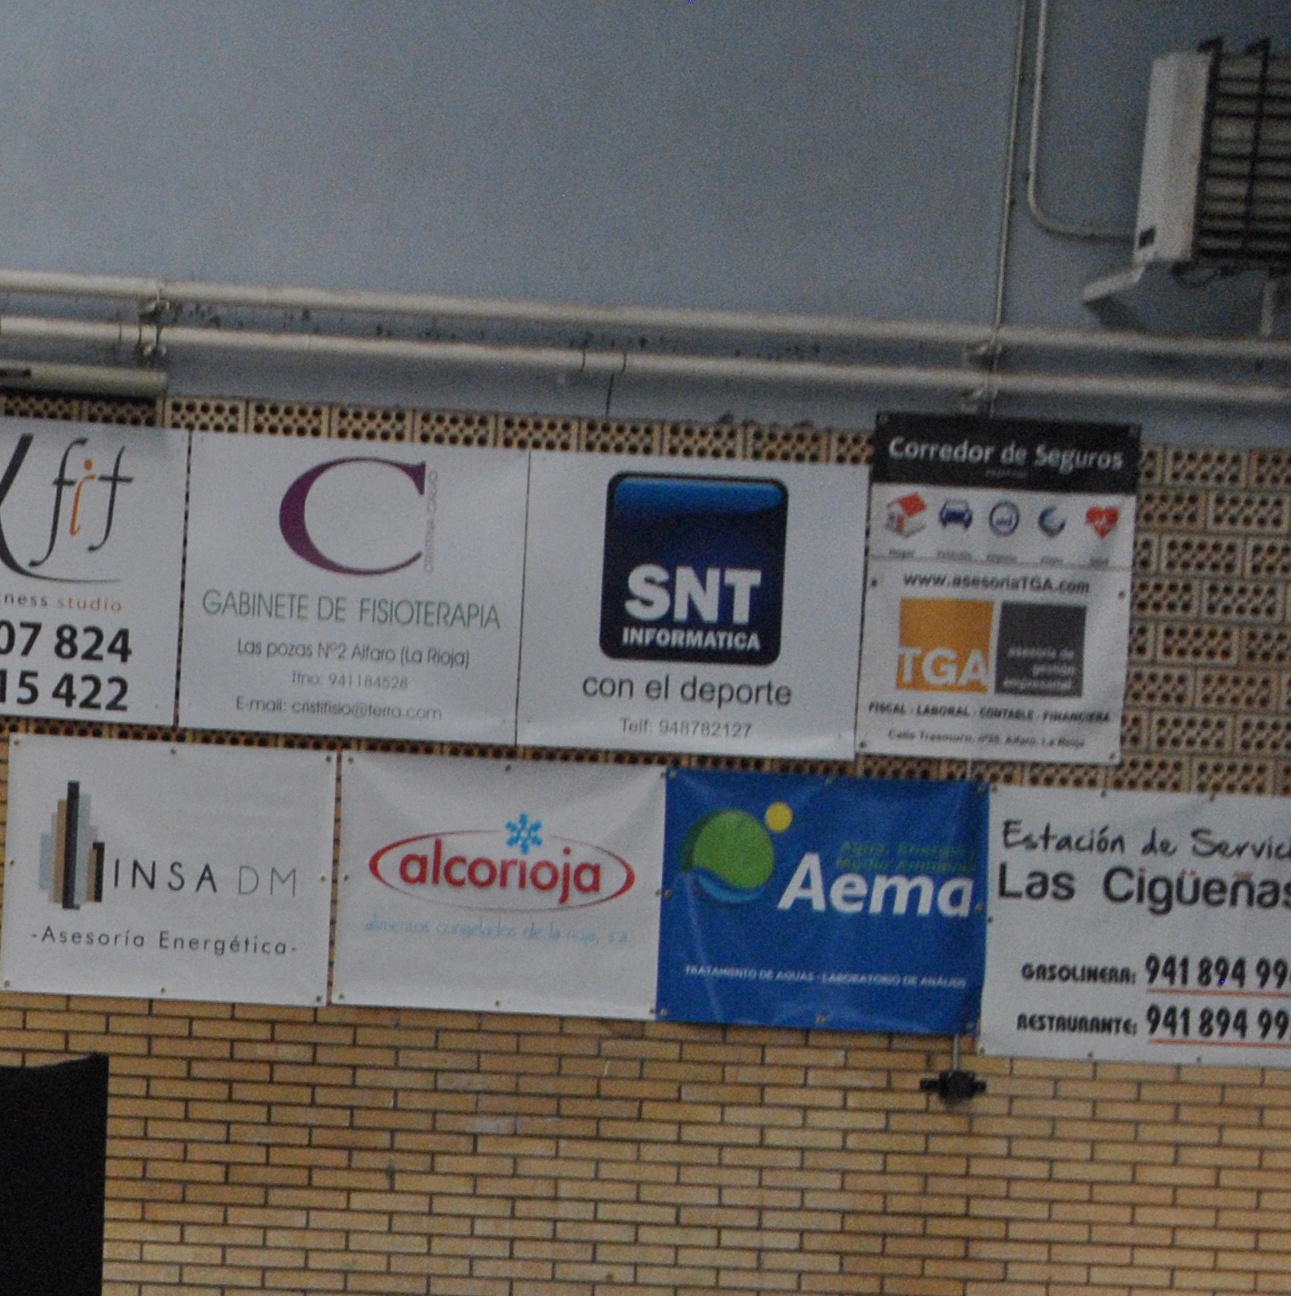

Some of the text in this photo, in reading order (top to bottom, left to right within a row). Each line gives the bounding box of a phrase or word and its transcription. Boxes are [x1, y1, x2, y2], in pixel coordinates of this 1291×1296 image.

[887, 435, 996, 465] Corredor
[1001, 441, 1028, 466] de
[1033, 443, 1125, 475] Seguros
[278, 456, 427, 576] C
[56, 596, 123, 613] studio
[202, 587, 502, 630] GABINETE DE FISIOTERAPIA
[623, 562, 762, 627] SNT
[53, 622, 133, 664] 824
[236, 638, 262, 657] Las
[266, 641, 313, 659] pozas
[351, 643, 396, 664] Alfaro
[427, 646, 471, 671] Rioja)
[621, 626, 761, 651] INFORMATICA
[898, 646, 990, 688] TGA
[51, 671, 130, 713] 422
[581, 673, 793, 709] con el deporte
[916, 703, 970, 718] LABORAL
[1002, 818, 1126, 855] Estación
[1140, 827, 1177, 856] de
[114, 857, 297, 897] INSA DM
[399, 837, 601, 905] alcorioja
[776, 852, 975, 918] Aema
[998, 861, 1076, 902] Las
[685, 964, 757, 980] TRATAMIENTO
[759, 968, 774, 980] DE
[776, 970, 815, 982] AGUAS
[822, 972, 901, 986] LABORATORIO
[902, 974, 919, 986] DE
[1020, 962, 1137, 985] GASOLINERA:
[1145, 953, 1190, 986] 941
[1197, 956, 1247, 989] 894
[1016, 1012, 1138, 1036] RESTAURANTE:
[1146, 1004, 1191, 1037] 941
[1198, 1006, 1248, 1040] 894
